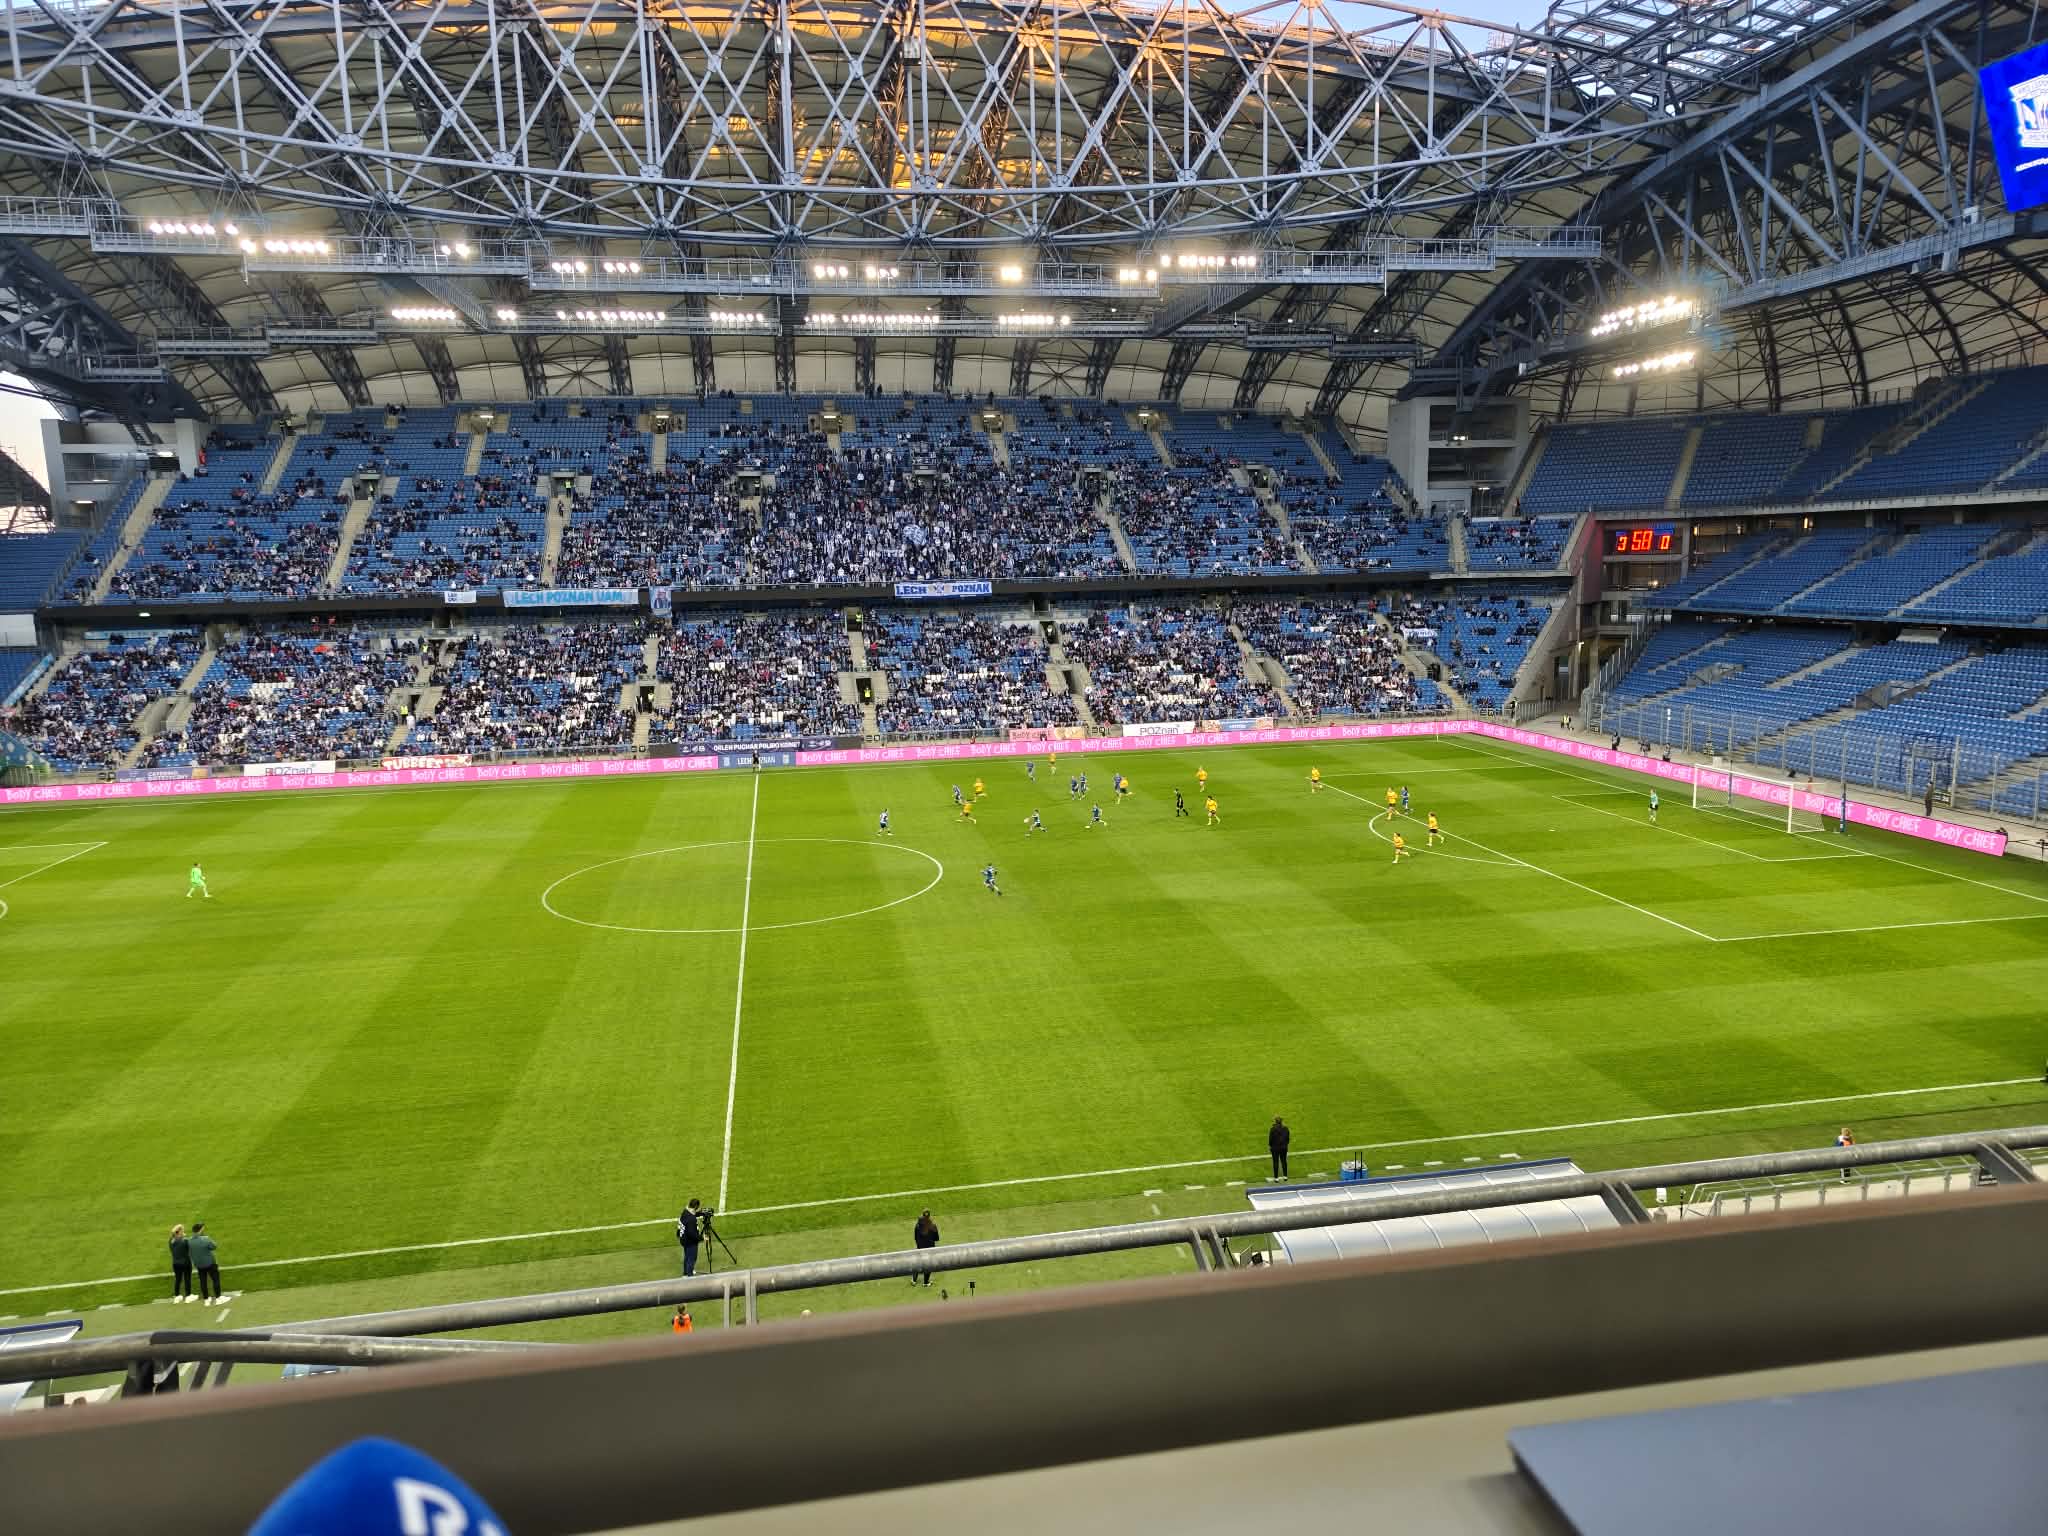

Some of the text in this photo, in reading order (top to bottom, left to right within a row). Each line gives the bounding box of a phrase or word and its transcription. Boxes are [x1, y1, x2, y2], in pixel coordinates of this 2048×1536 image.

[1617, 530, 1671, 551] 3 58 0
[896, 585, 927, 595] LECH
[514, 591, 544, 605] LECH
[713, 743, 733, 751] ORLEN
